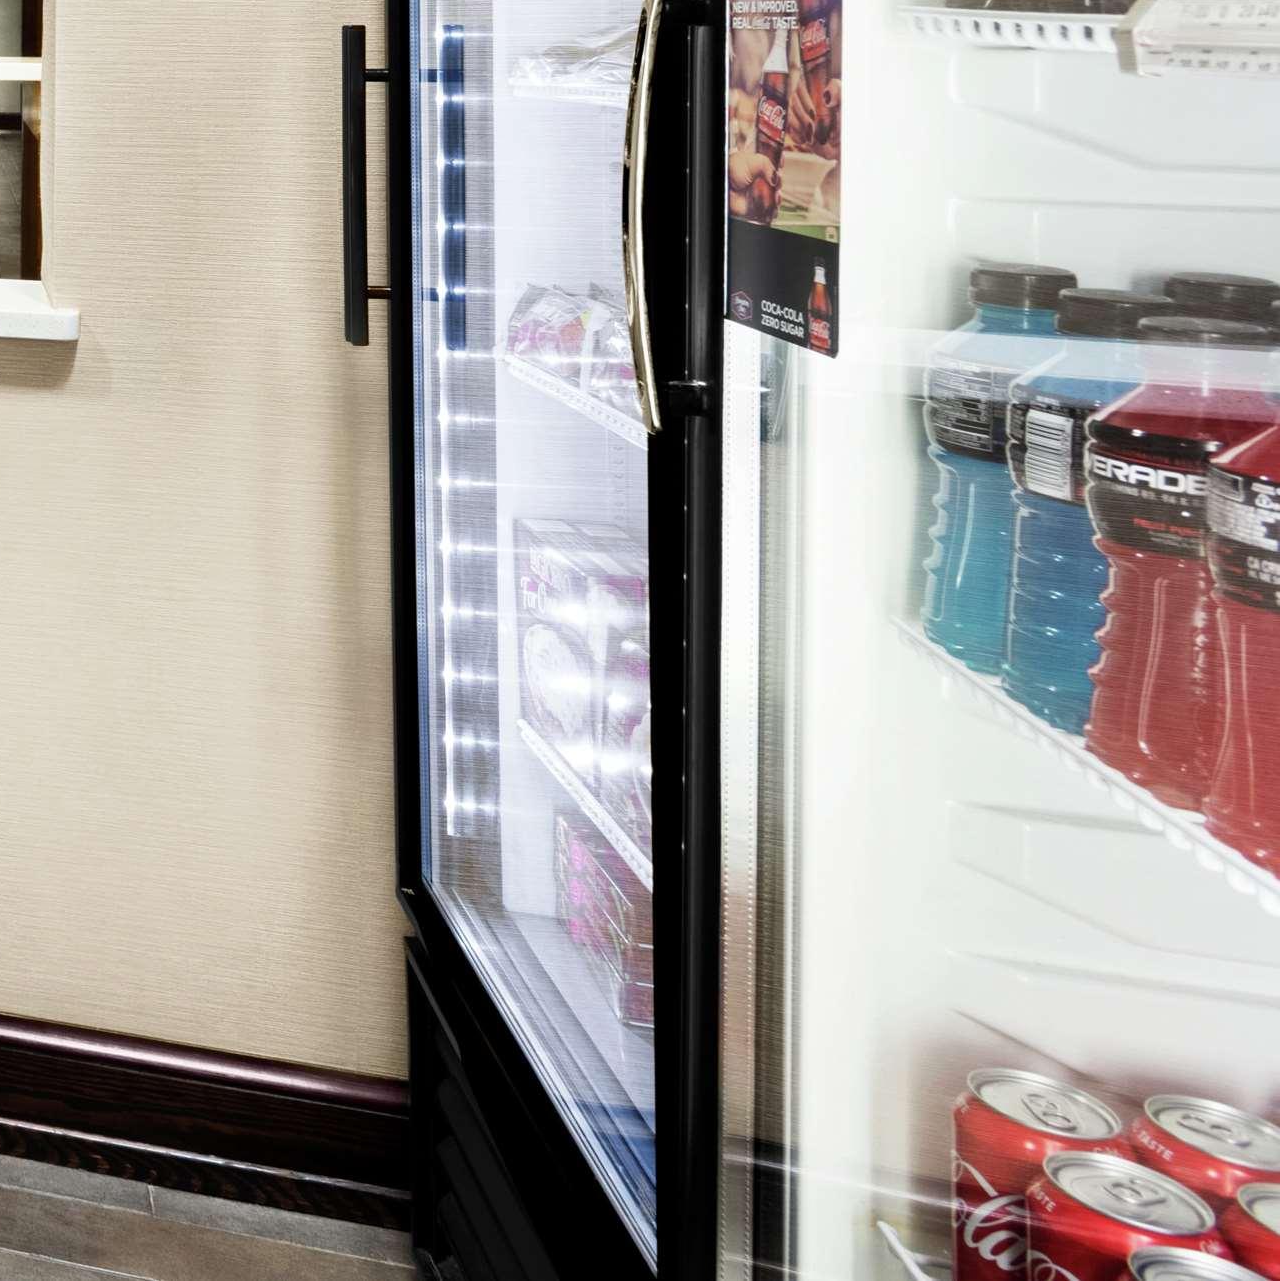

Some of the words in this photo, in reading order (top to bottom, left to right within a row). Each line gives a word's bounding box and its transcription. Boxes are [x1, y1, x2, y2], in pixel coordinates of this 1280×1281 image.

[732, 2, 749, 13] NEW
[757, 0, 799, 13] IMPROVED.
[732, 17, 752, 29] REAL
[773, 16, 799, 29] TASTE.
[761, 300, 804, 324] COCA-COLA
[761, 314, 779, 329] ZERO
[780, 321, 804, 338] SUGAR
